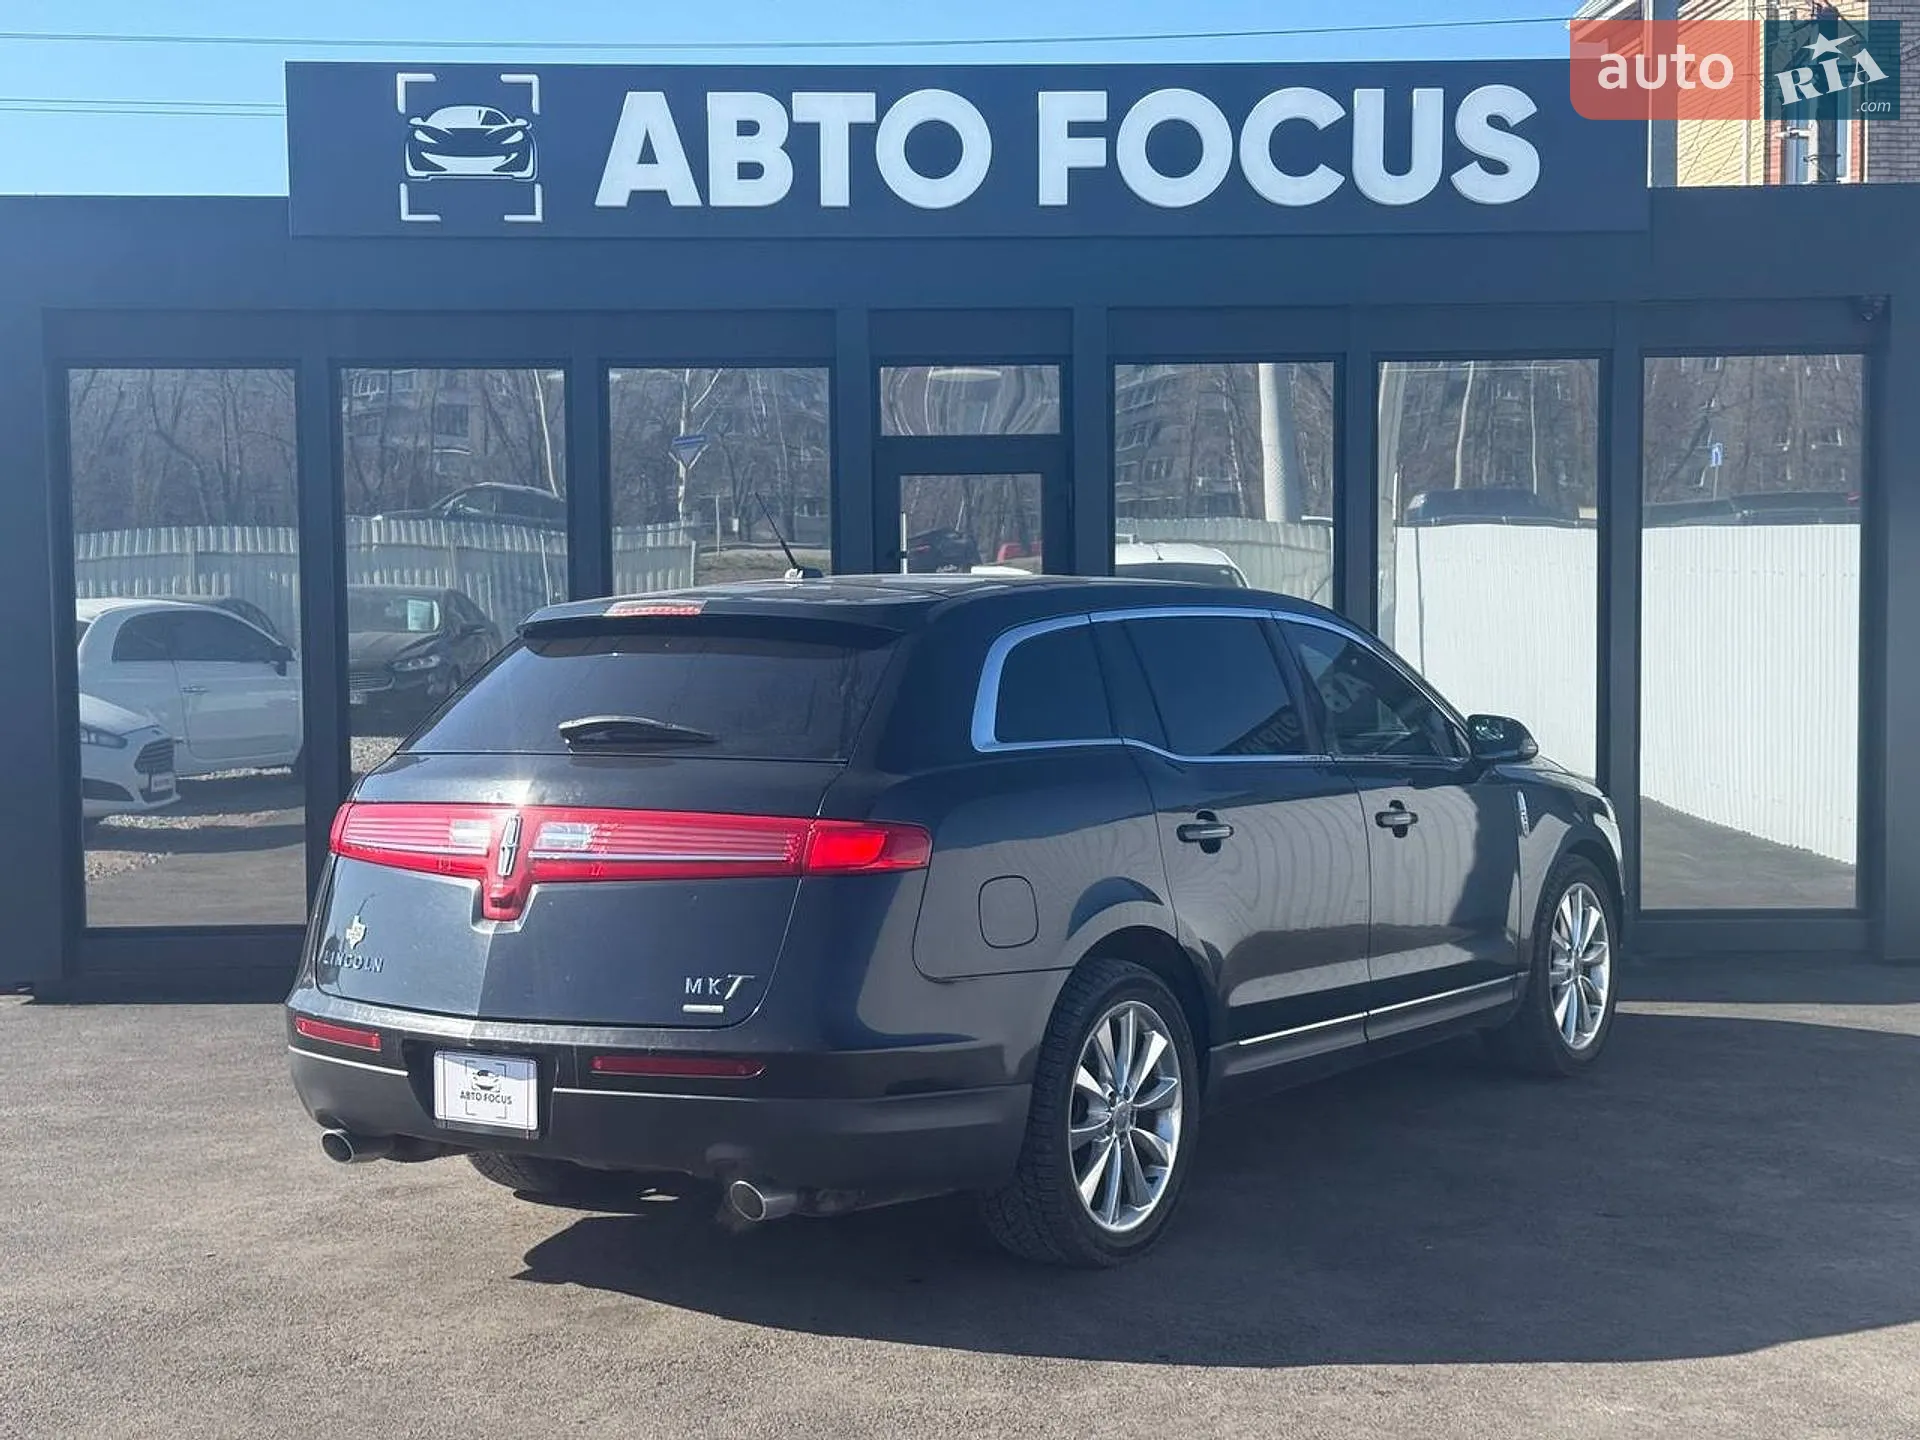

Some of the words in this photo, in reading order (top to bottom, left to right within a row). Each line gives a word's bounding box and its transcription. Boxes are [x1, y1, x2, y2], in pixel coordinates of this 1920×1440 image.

[594, 88, 993, 209] АВТО
[1037, 84, 1541, 208] FOCUS
[483, 1093, 513, 1105] FOCUS
